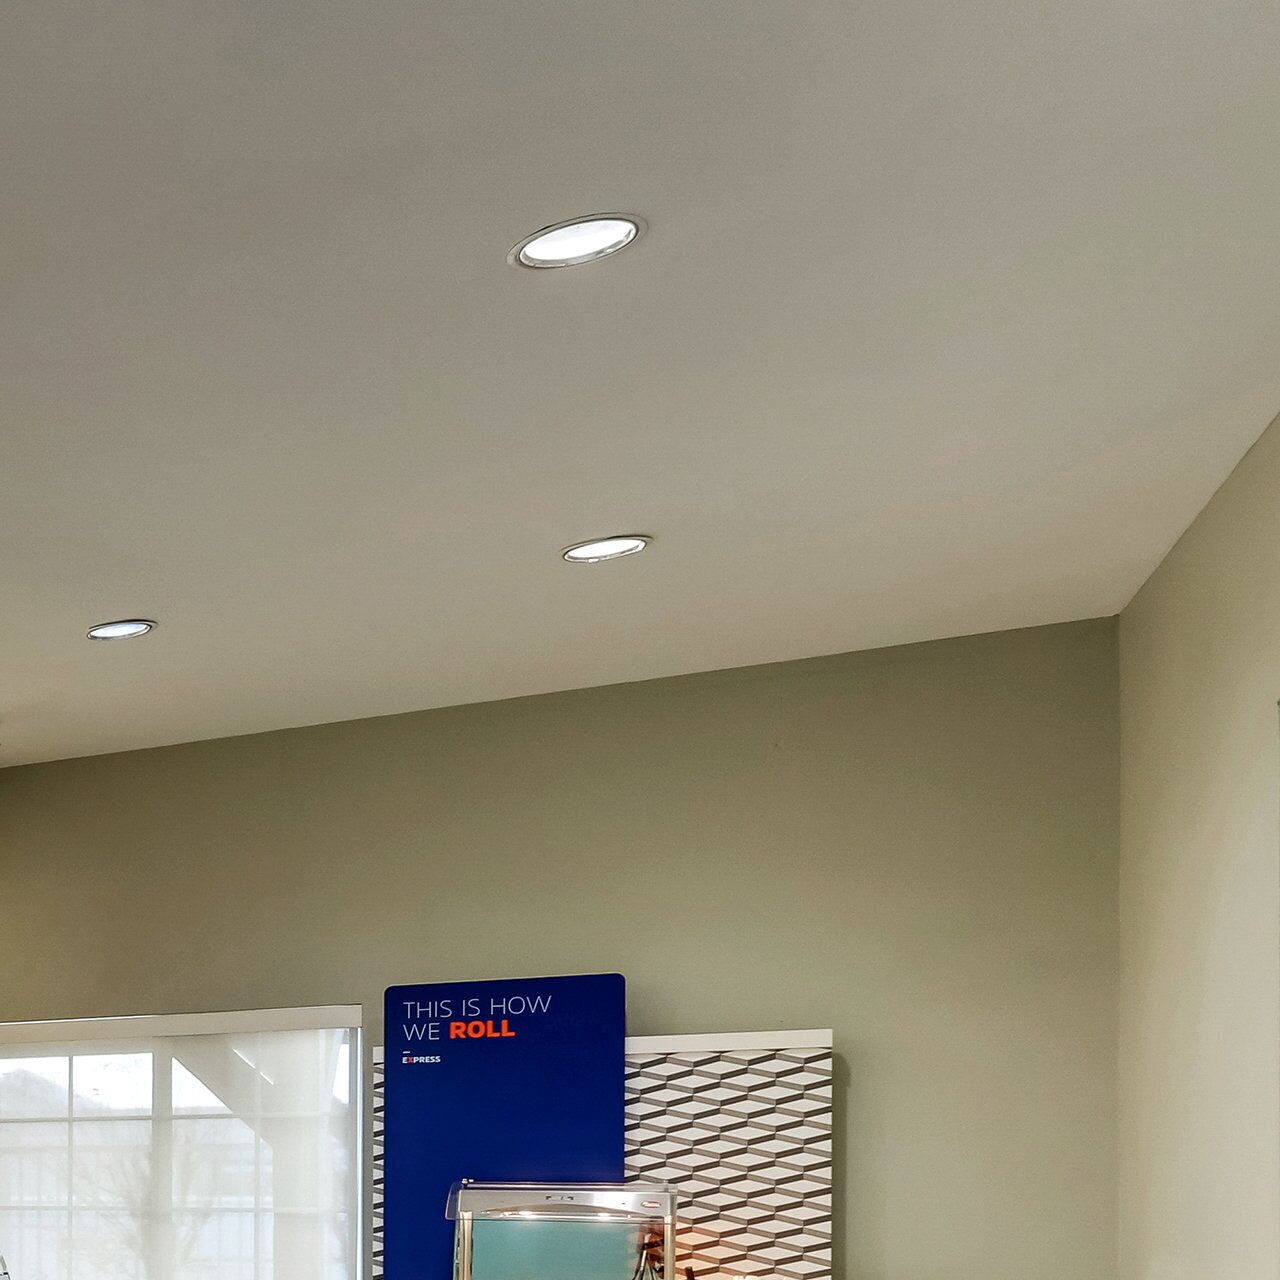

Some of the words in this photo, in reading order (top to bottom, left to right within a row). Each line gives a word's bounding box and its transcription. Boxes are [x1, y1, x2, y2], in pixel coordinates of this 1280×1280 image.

[403, 1000, 453, 1019] THIS
[462, 998, 481, 1017] IS
[490, 995, 553, 1016] HOW
[403, 1022, 441, 1041] WE
[448, 1019, 517, 1040] ROLL
[402, 1055, 442, 1064] EXPRESS
